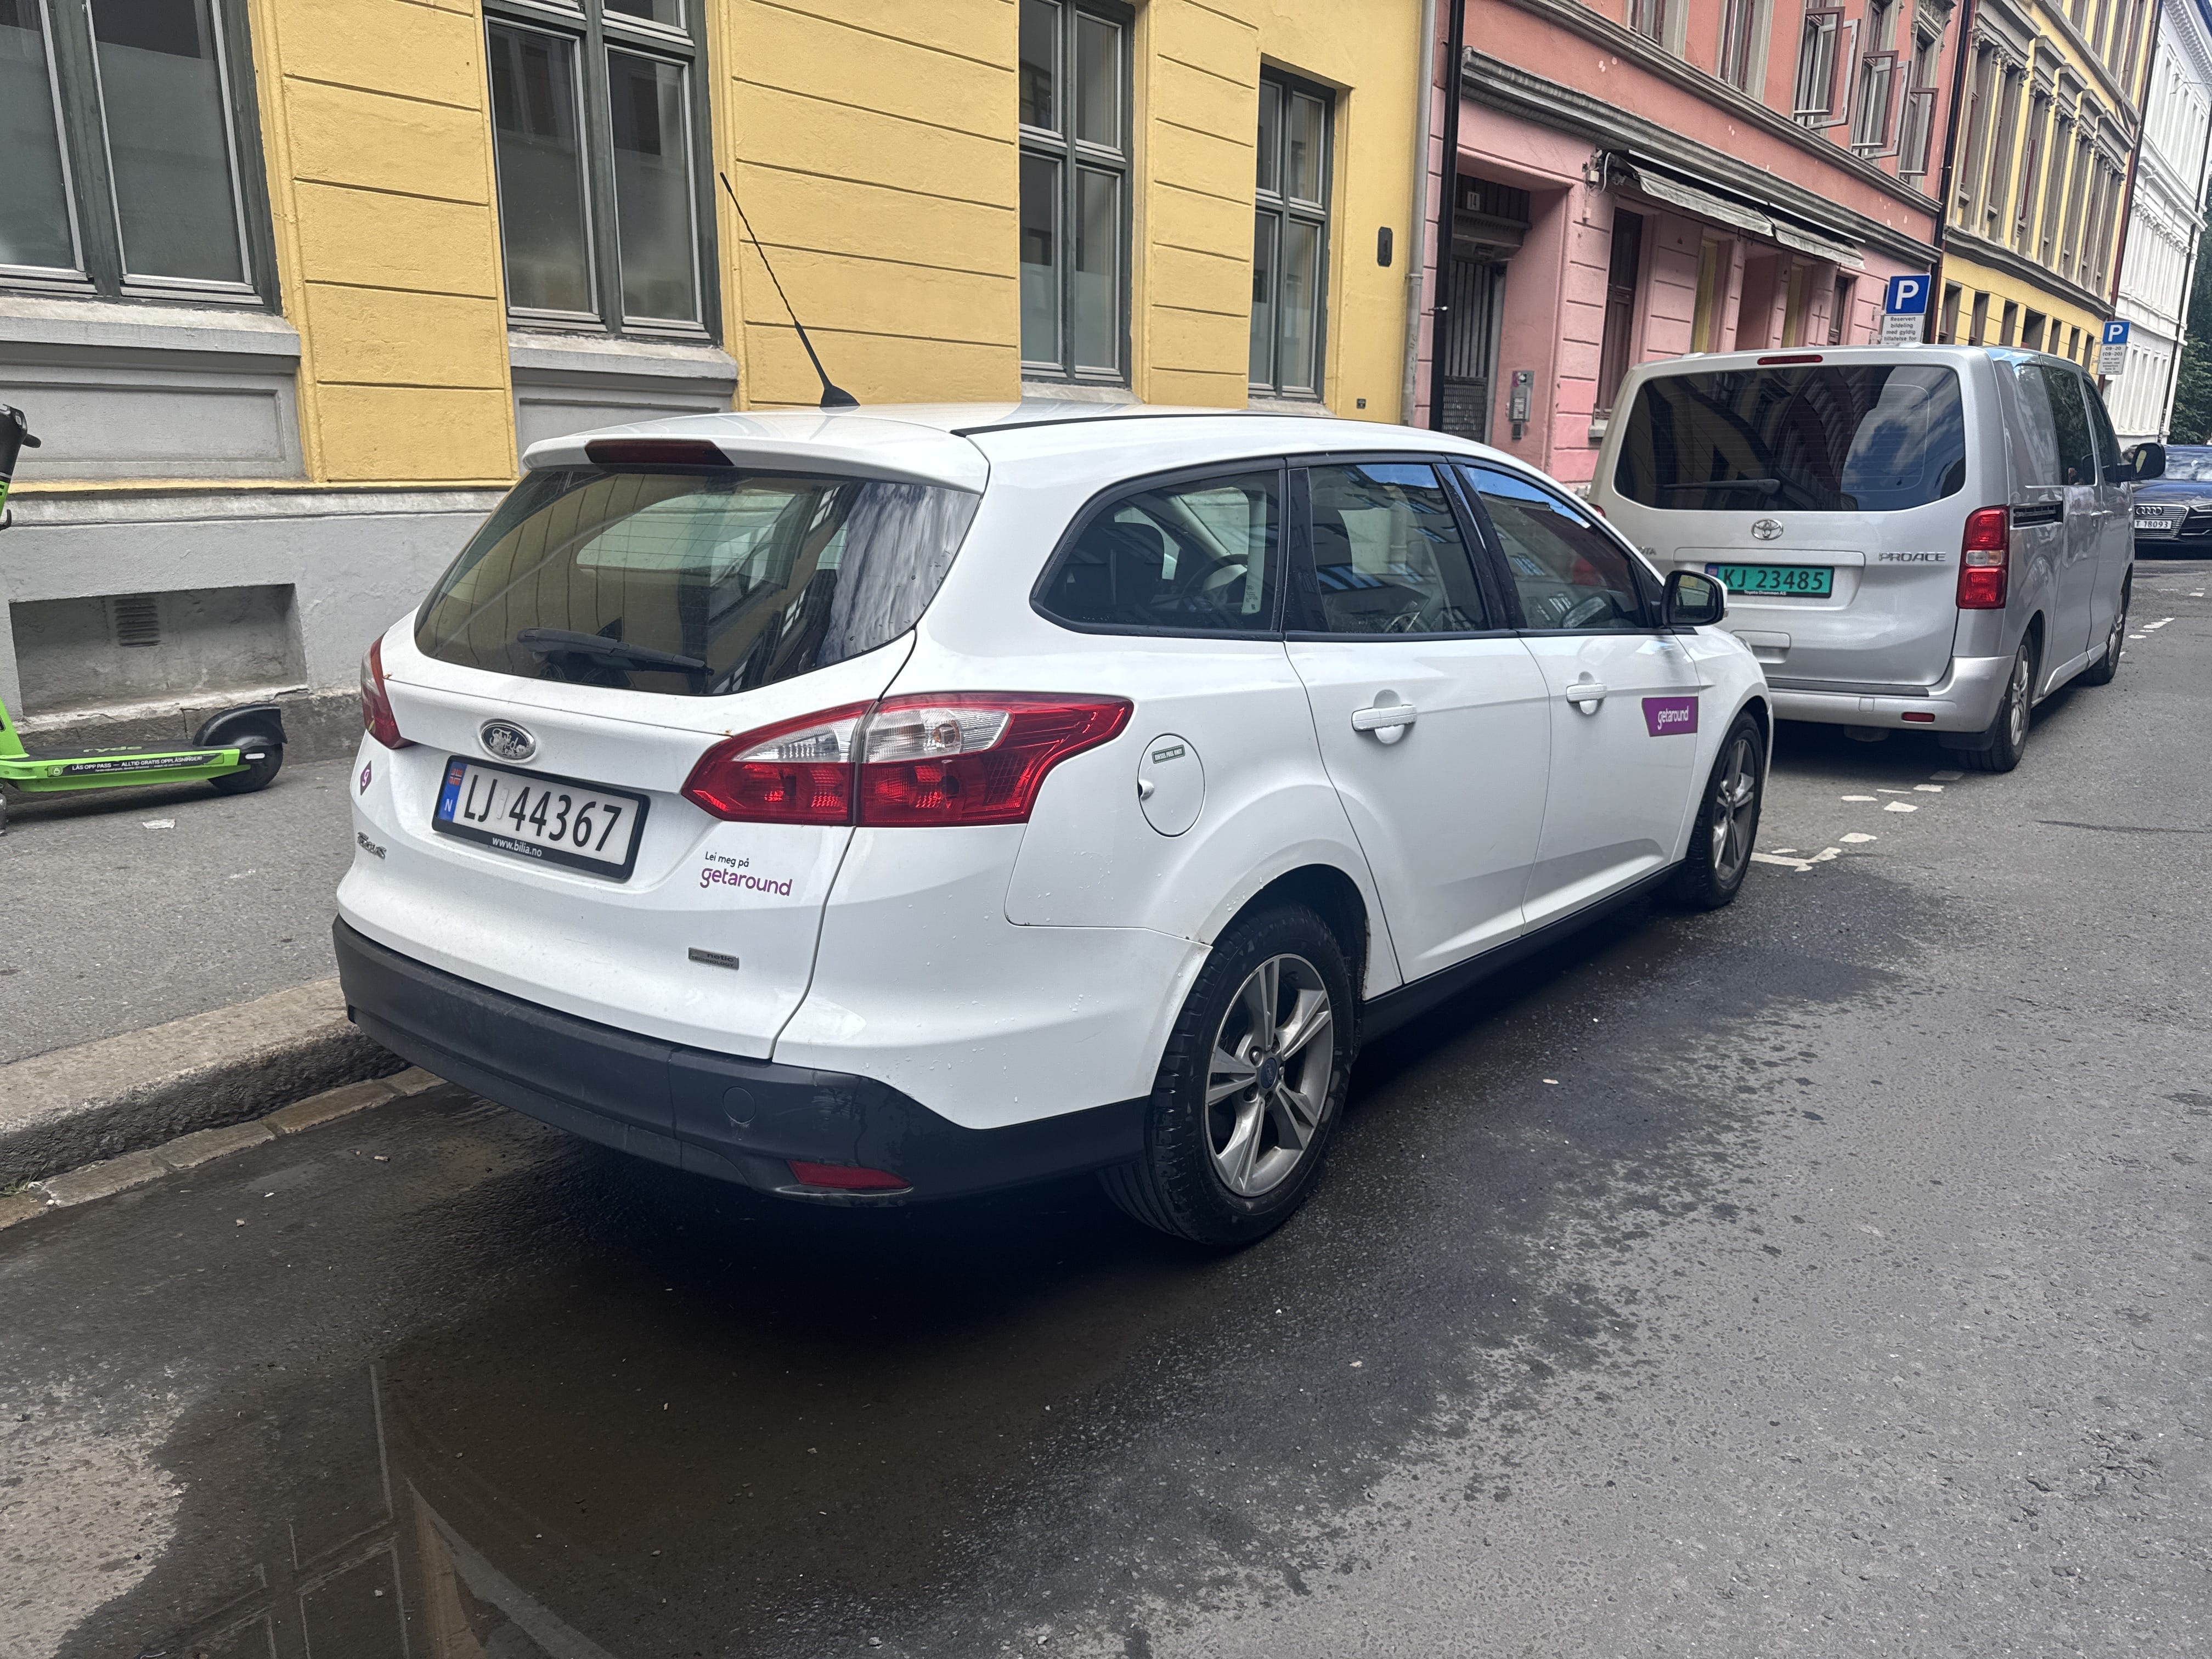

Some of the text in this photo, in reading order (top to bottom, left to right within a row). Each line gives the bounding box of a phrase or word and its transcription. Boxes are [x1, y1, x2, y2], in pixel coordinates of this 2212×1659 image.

[1470, 193, 1476, 207] 14
[1894, 280, 1919, 310] P
[2108, 324, 2123, 342] P
[1878, 551, 1946, 562] PROACE
[1723, 568, 1824, 590] KJ 23485
[1657, 705, 1689, 730] getaround
[444, 798, 453, 812] N
[464, 774, 622, 852] LJ 44367
[492, 837, 542, 857] www.bilia.no
[705, 851, 749, 868] Lei meg på
[699, 868, 793, 896] getaround
